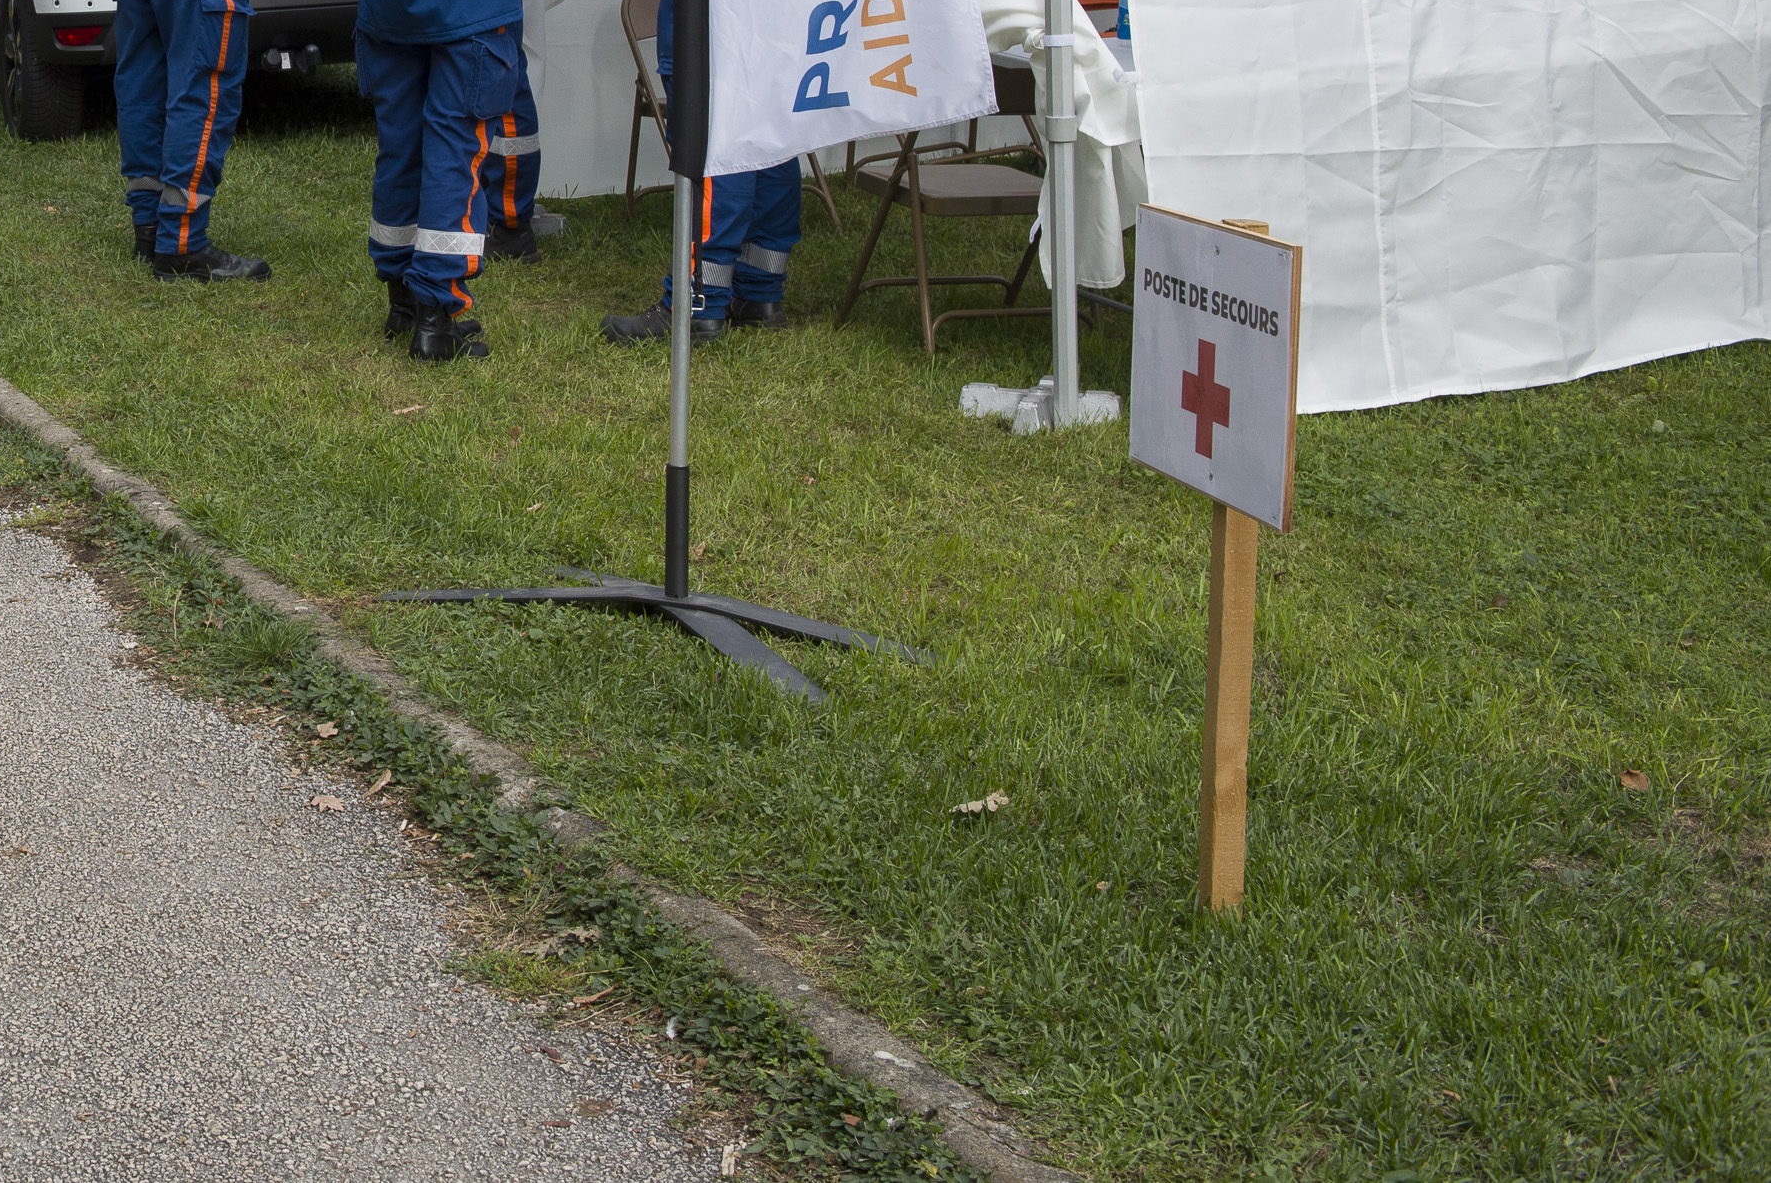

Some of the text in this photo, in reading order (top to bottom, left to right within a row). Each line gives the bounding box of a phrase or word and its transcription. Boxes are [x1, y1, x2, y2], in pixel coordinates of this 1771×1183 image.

[1143, 267, 1280, 338] POSTE DE SECOURS
